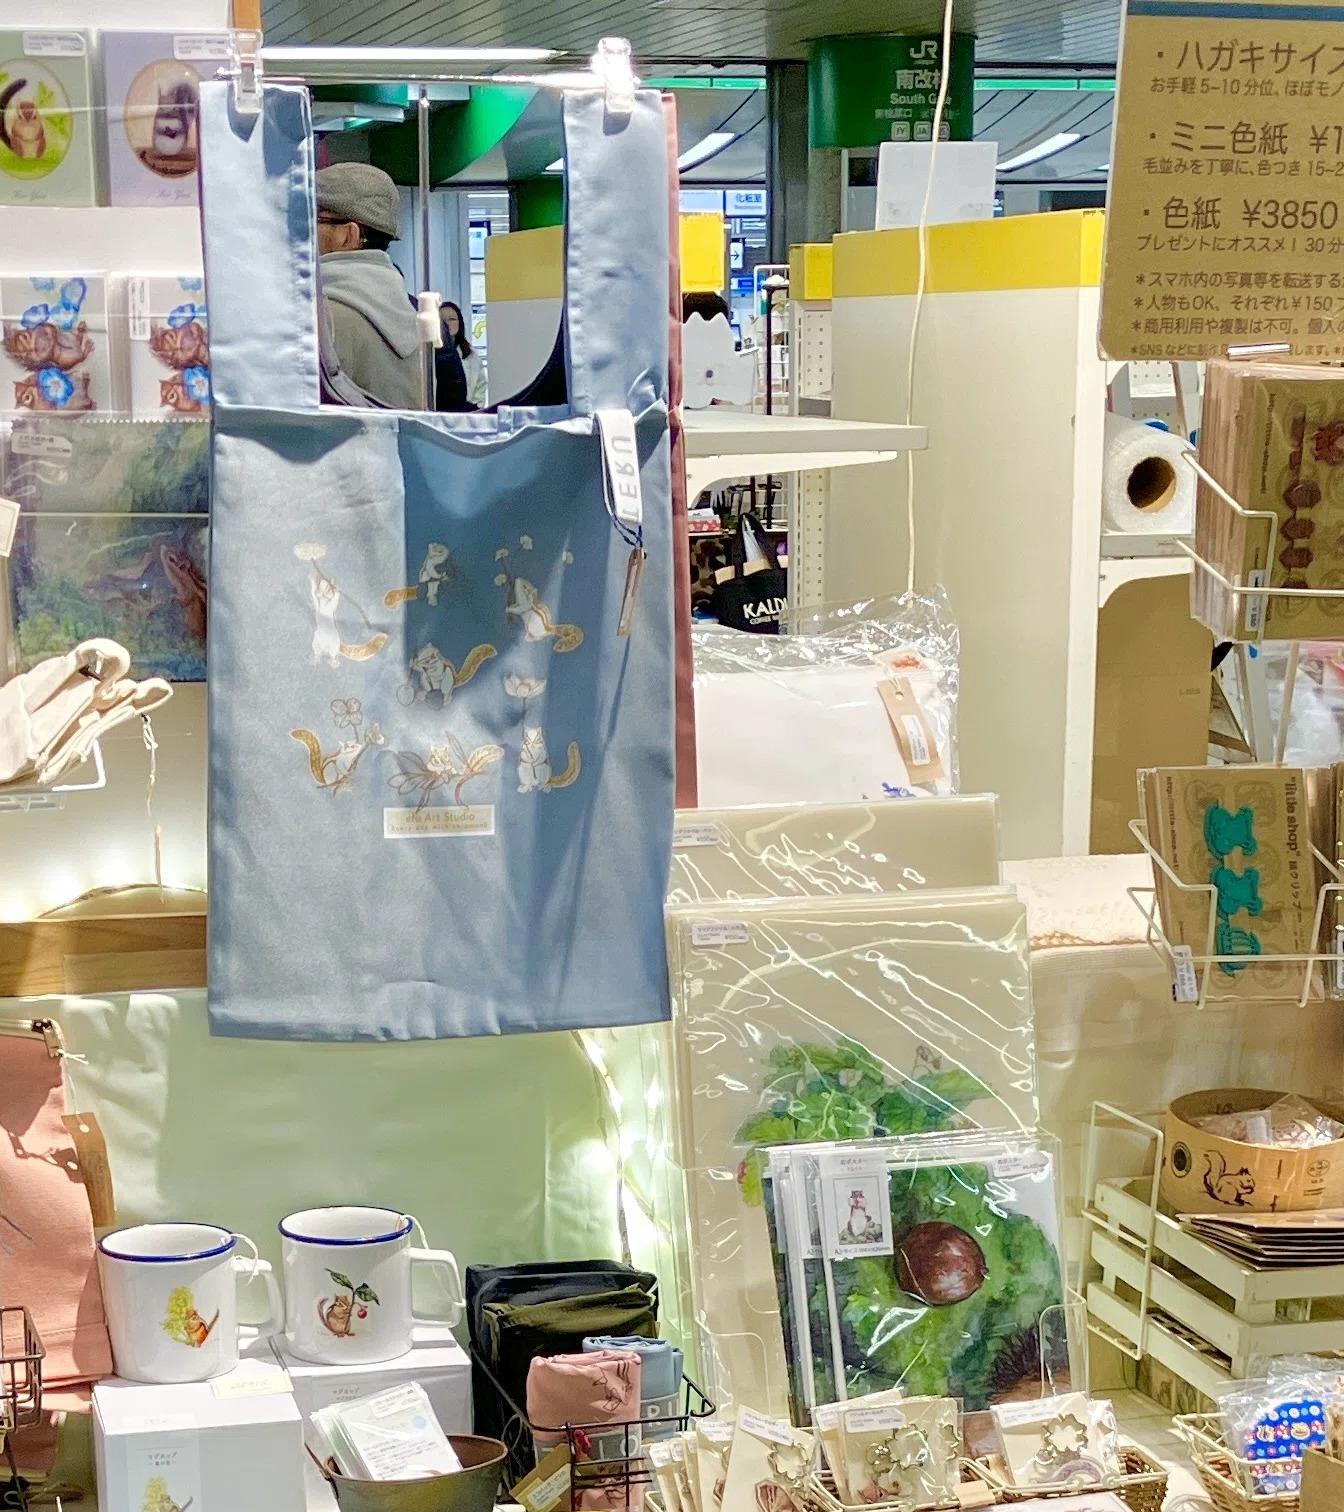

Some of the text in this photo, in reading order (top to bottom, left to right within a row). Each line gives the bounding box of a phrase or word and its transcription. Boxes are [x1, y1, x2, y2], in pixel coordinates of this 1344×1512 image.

[909, 41, 938, 58] JR
[890, 93, 925, 105] South
[1171, 120, 1289, 157] ミニ色紙
[1163, 196, 1222, 231] 色紙
